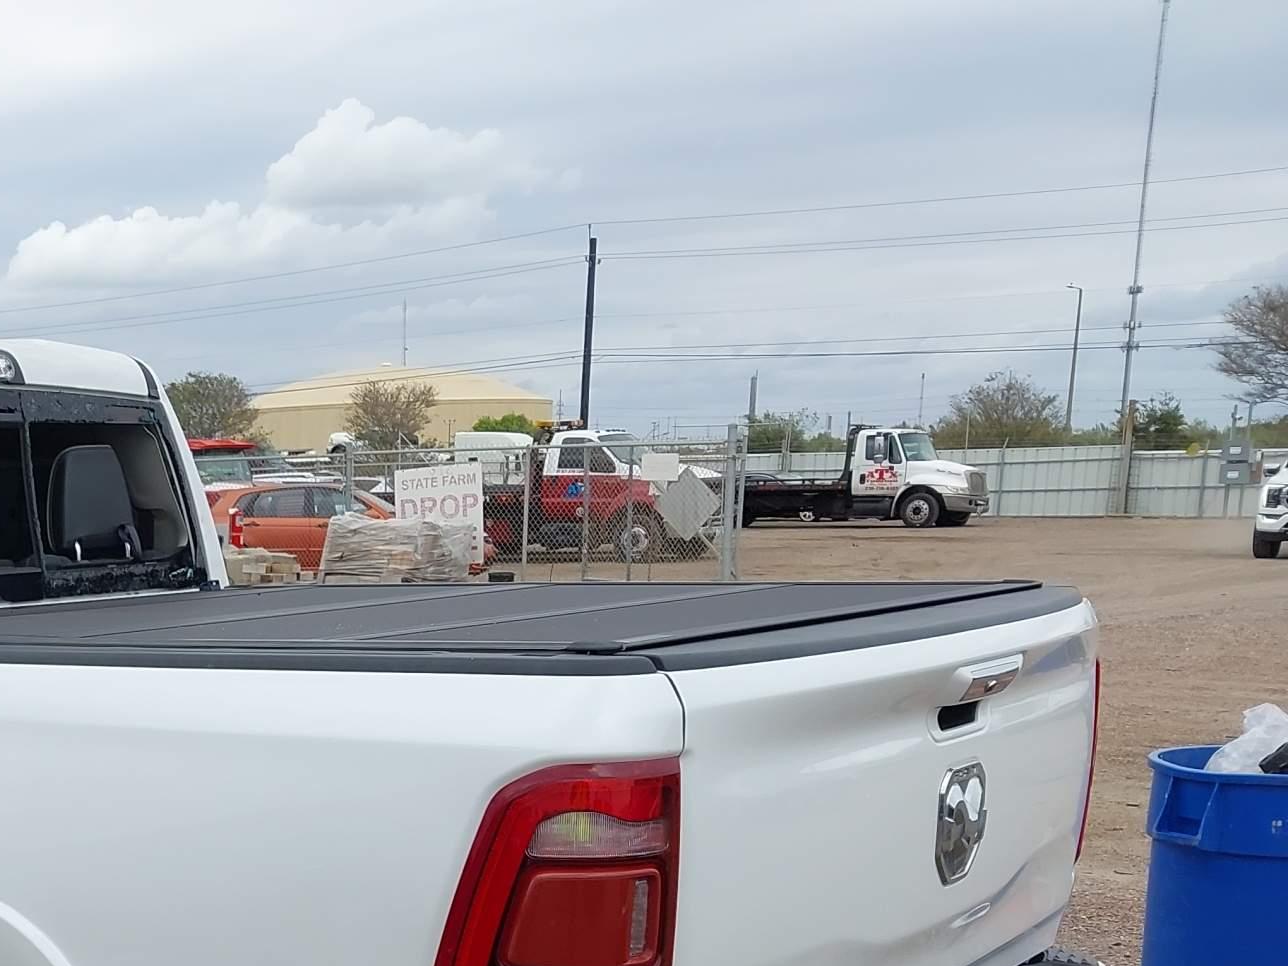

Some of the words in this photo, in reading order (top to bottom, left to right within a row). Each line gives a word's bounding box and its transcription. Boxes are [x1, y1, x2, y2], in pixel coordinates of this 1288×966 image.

[401, 476, 438, 491] STATE
[442, 473, 477, 487] FARM
[400, 493, 479, 519] DROP
